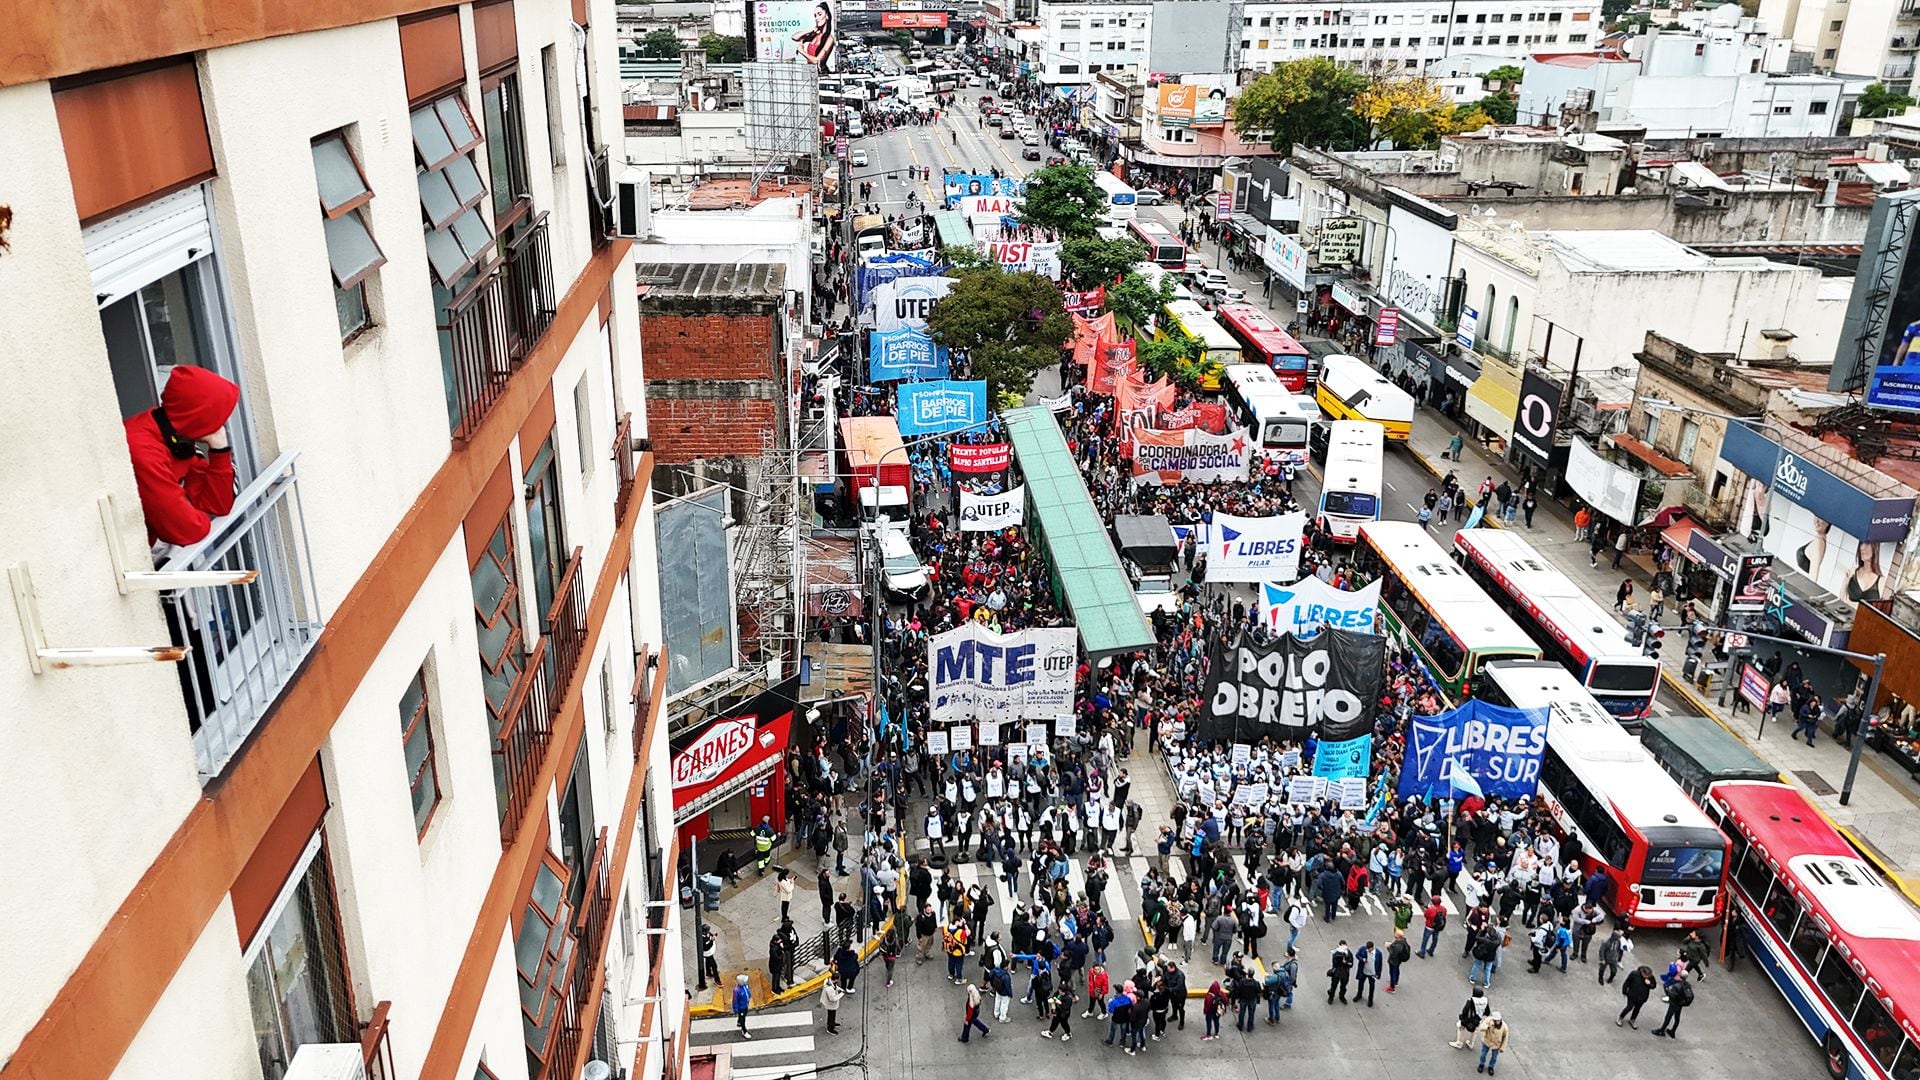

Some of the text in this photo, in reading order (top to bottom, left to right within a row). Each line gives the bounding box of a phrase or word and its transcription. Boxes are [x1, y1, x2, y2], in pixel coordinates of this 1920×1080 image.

[991, 243, 1032, 263] MST
[889, 340, 930, 352] BARRIOS
[889, 350, 931, 362] DE PIE
[922, 398, 966, 408] BARRIOS
[922, 406, 967, 419] DE PIE
[1140, 443, 1228, 459] COORDINADORA
[1151, 458, 1198, 471] CAMBIO
[1199, 455, 1241, 469] SOCIAL
[977, 502, 1010, 517] UTEP
[1238, 539, 1295, 556] LIBRES
[1722, 555, 1737, 576] La
[1293, 604, 1374, 628] LIBRES
[936, 640, 1036, 686] MTE
[1044, 655, 1073, 671] UTEP
[1237, 647, 1331, 689] POLO
[1211, 681, 1362, 727] OBRERO
[1445, 720, 1547, 755] LIBRES
[677, 722, 749, 782] CARNES
[1486, 755, 1540, 783] SUR
[1551, 800, 1564, 821] 161
[1719, 798, 1894, 1014] OLIVOS 152 BOCA
